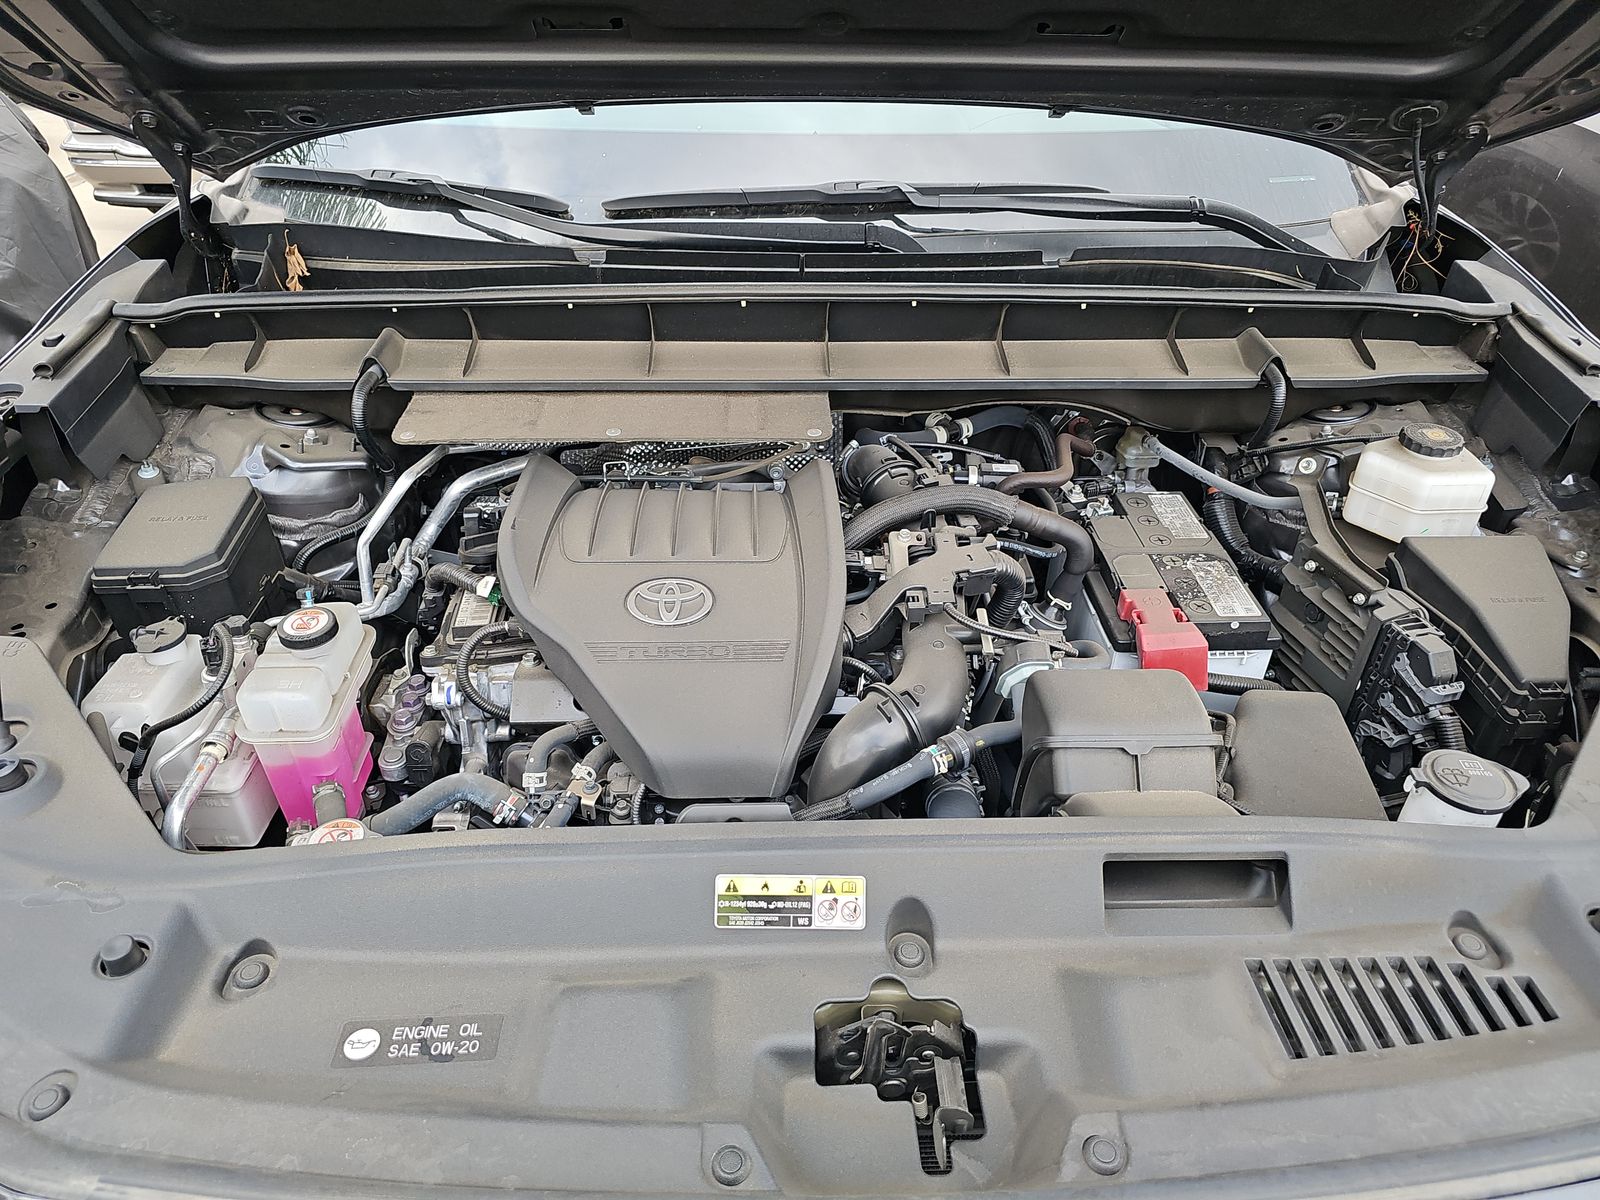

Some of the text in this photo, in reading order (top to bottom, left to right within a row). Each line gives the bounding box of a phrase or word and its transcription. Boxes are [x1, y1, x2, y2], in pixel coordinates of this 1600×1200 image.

[619, 645, 731, 658] TURBO
[797, 917, 810, 926] WS
[392, 1023, 482, 1040] ENGINE OIL
[387, 1040, 480, 1058] SAE 0W-20
